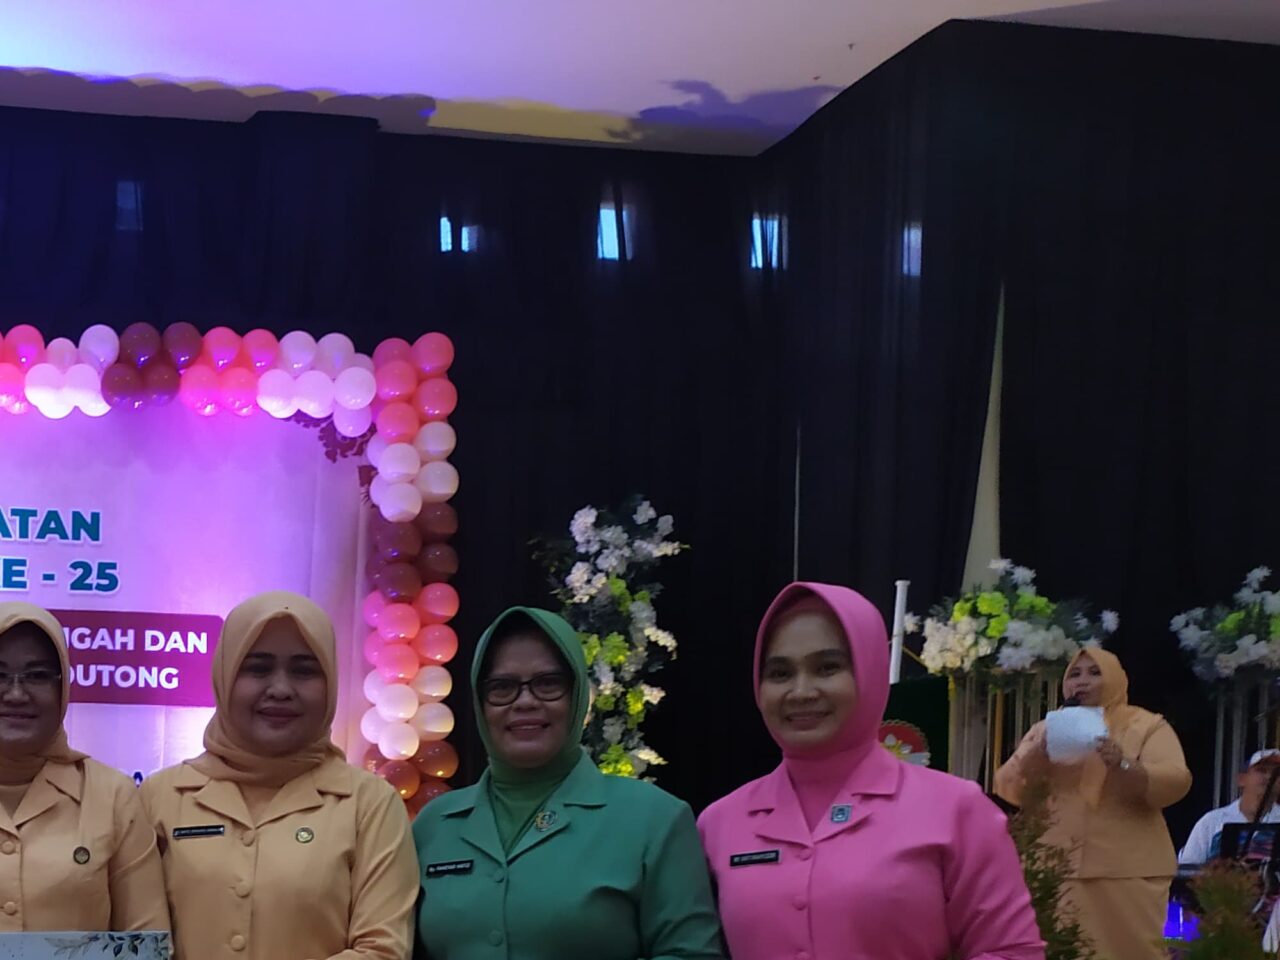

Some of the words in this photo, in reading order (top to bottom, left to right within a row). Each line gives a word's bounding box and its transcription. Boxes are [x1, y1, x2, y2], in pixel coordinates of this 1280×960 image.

[69, 561, 120, 593] 25
[144, 629, 208, 654] DAN
[69, 664, 180, 690] UTONG
